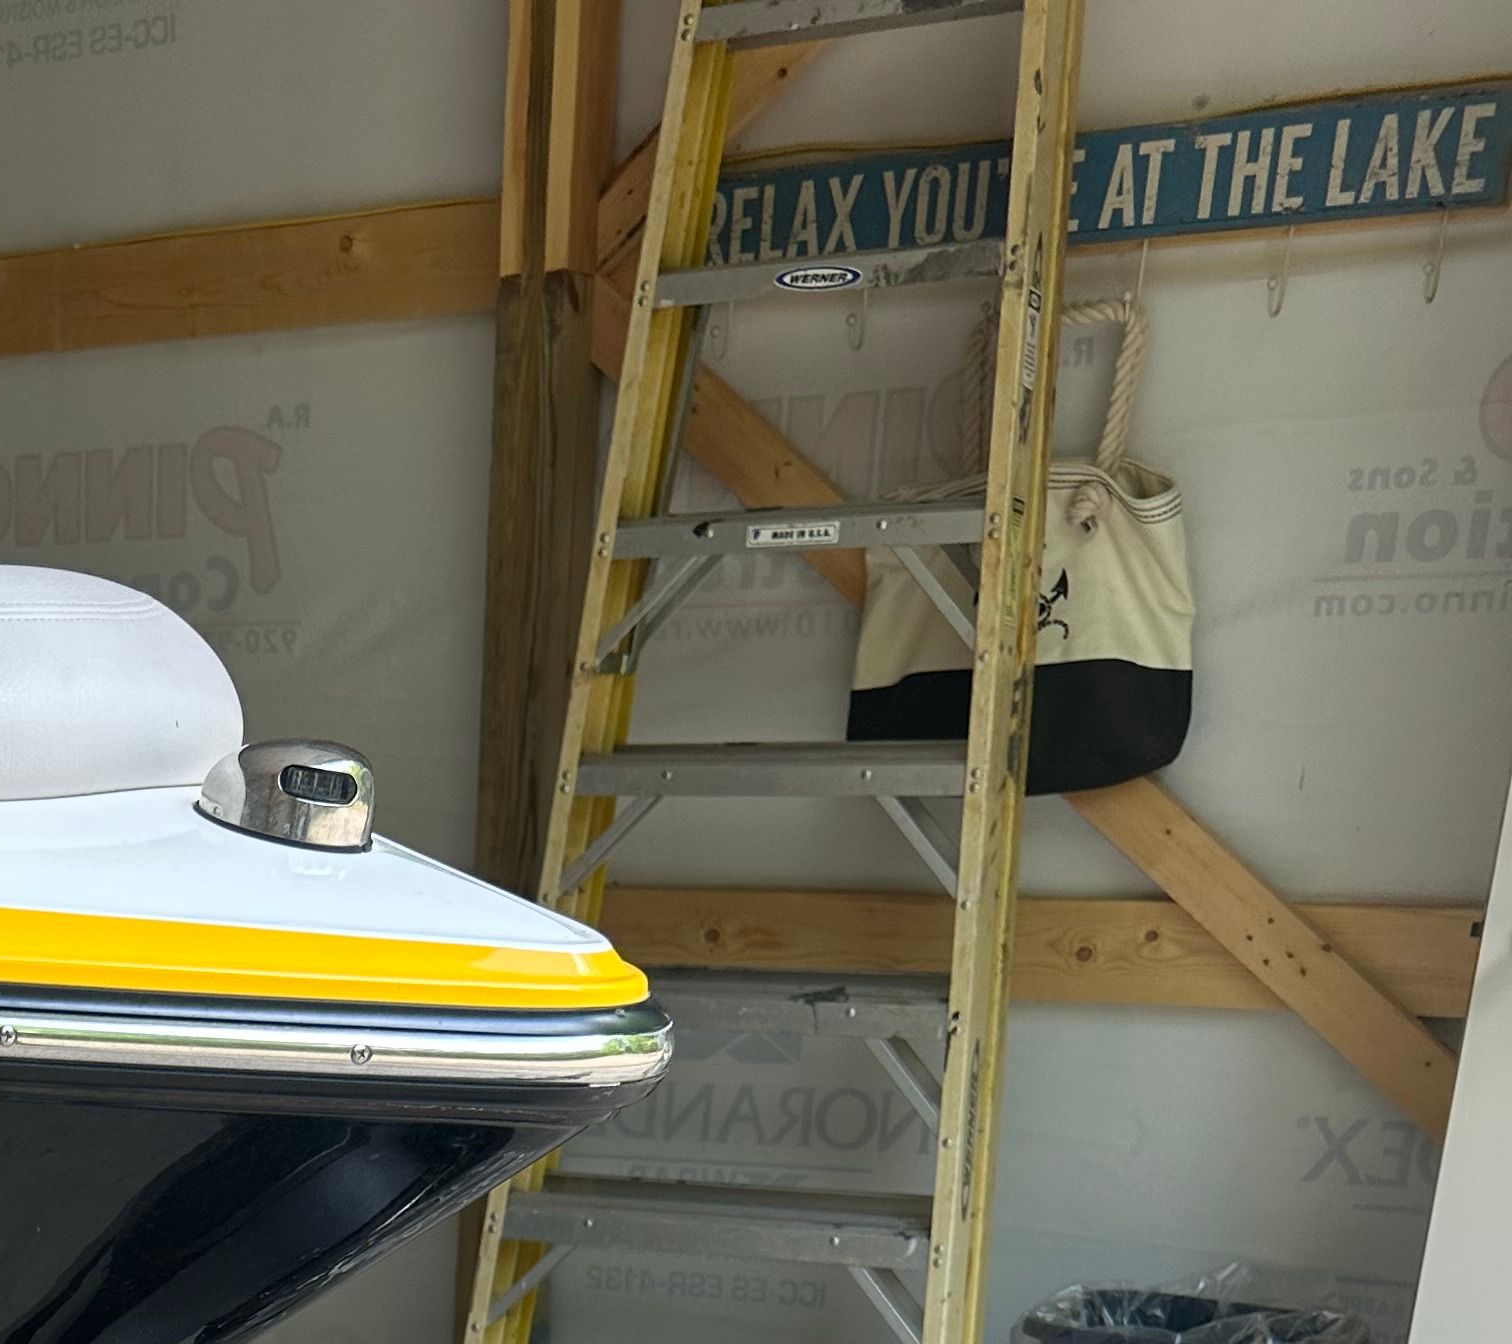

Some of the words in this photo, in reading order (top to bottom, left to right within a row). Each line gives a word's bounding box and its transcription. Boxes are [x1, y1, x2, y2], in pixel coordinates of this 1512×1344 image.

[1096, 138, 1176, 229] AT
[1194, 122, 1313, 221] THE
[1323, 102, 1498, 208] LAKE
[788, 273, 849, 285] WERNER
